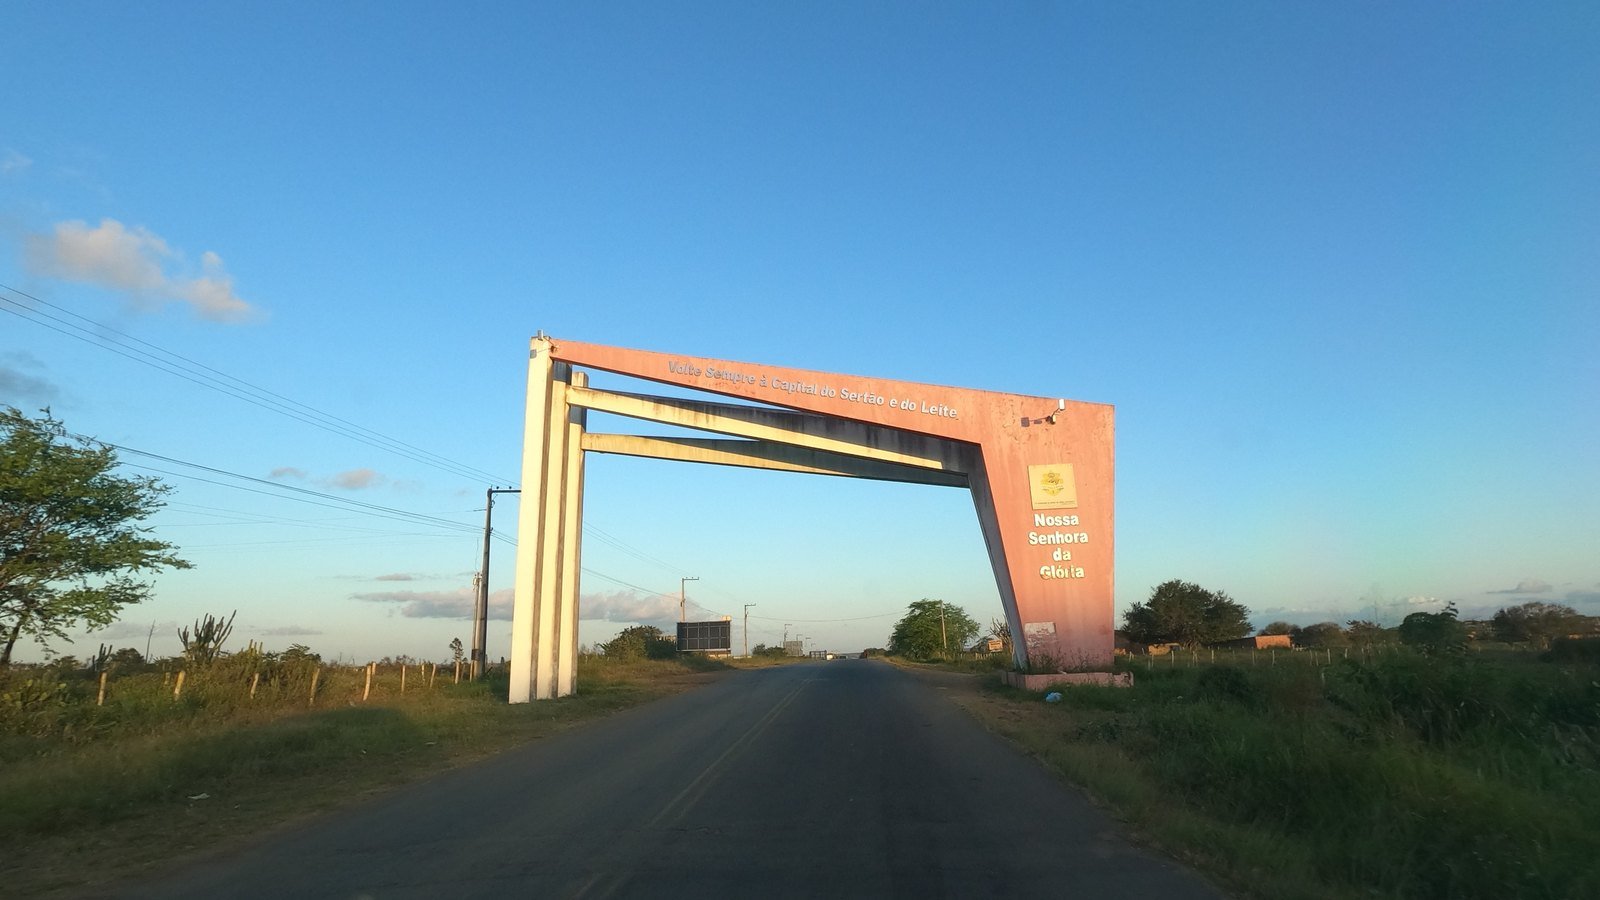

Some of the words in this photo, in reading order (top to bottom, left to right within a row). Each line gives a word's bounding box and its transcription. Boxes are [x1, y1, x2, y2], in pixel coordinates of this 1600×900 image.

[669, 361, 701, 376] Volte
[705, 367, 755, 383] Sempre
[759, 375, 768, 387] à
[771, 377, 816, 395] Capital
[821, 385, 836, 398] do
[840, 388, 885, 405] Sertão
[889, 399, 898, 408] e
[901, 398, 917, 411] do
[921, 401, 958, 418] Leite
[1034, 513, 1079, 527] Nossa
[1028, 531, 1089, 545] Senhora
[1053, 548, 1071, 561] da
[1040, 565, 1085, 579] Glória
